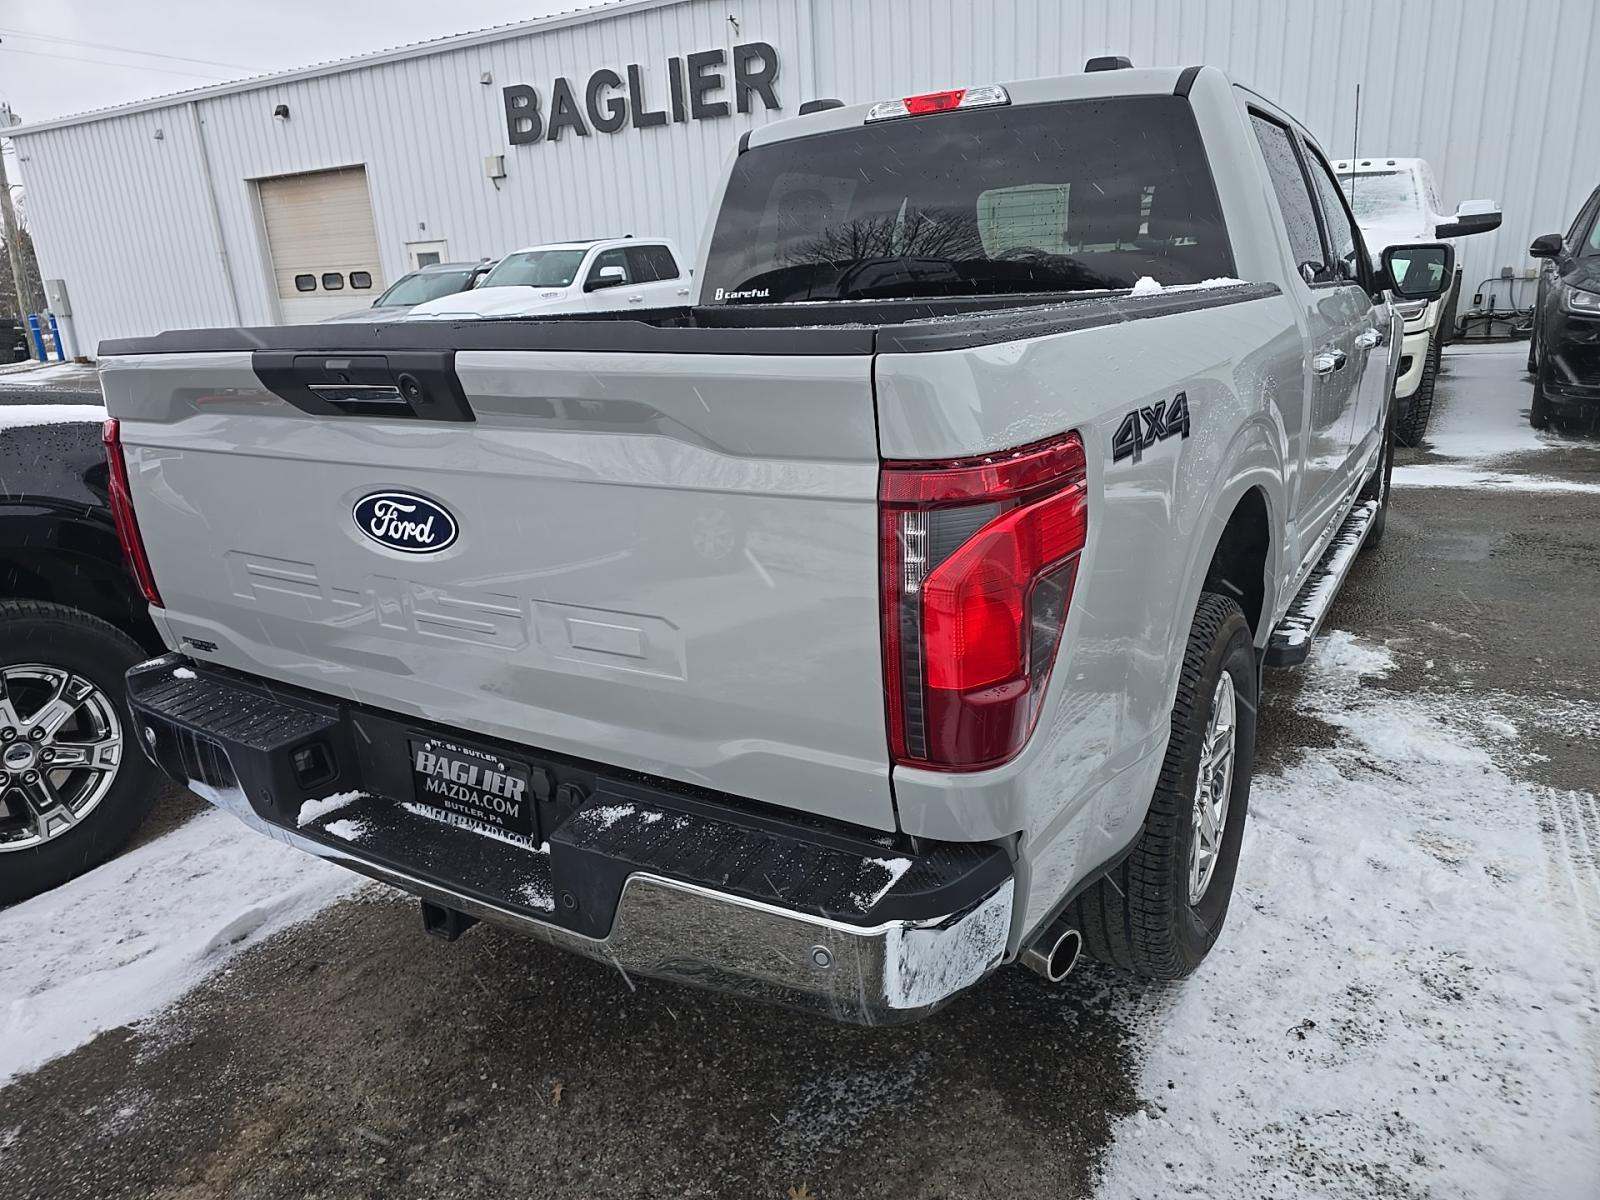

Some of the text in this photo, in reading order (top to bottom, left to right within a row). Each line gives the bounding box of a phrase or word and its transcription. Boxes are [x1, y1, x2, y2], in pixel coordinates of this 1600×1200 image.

[502, 41, 783, 146] BAGLIER
[724, 288, 770, 299] careful
[370, 498, 436, 545] Ford
[462, 747, 498, 763] BUTLER
[415, 750, 526, 802] BAGLIER
[425, 777, 520, 818] MAZDA.COM
[444, 800, 504, 824] BUTLER, PA
